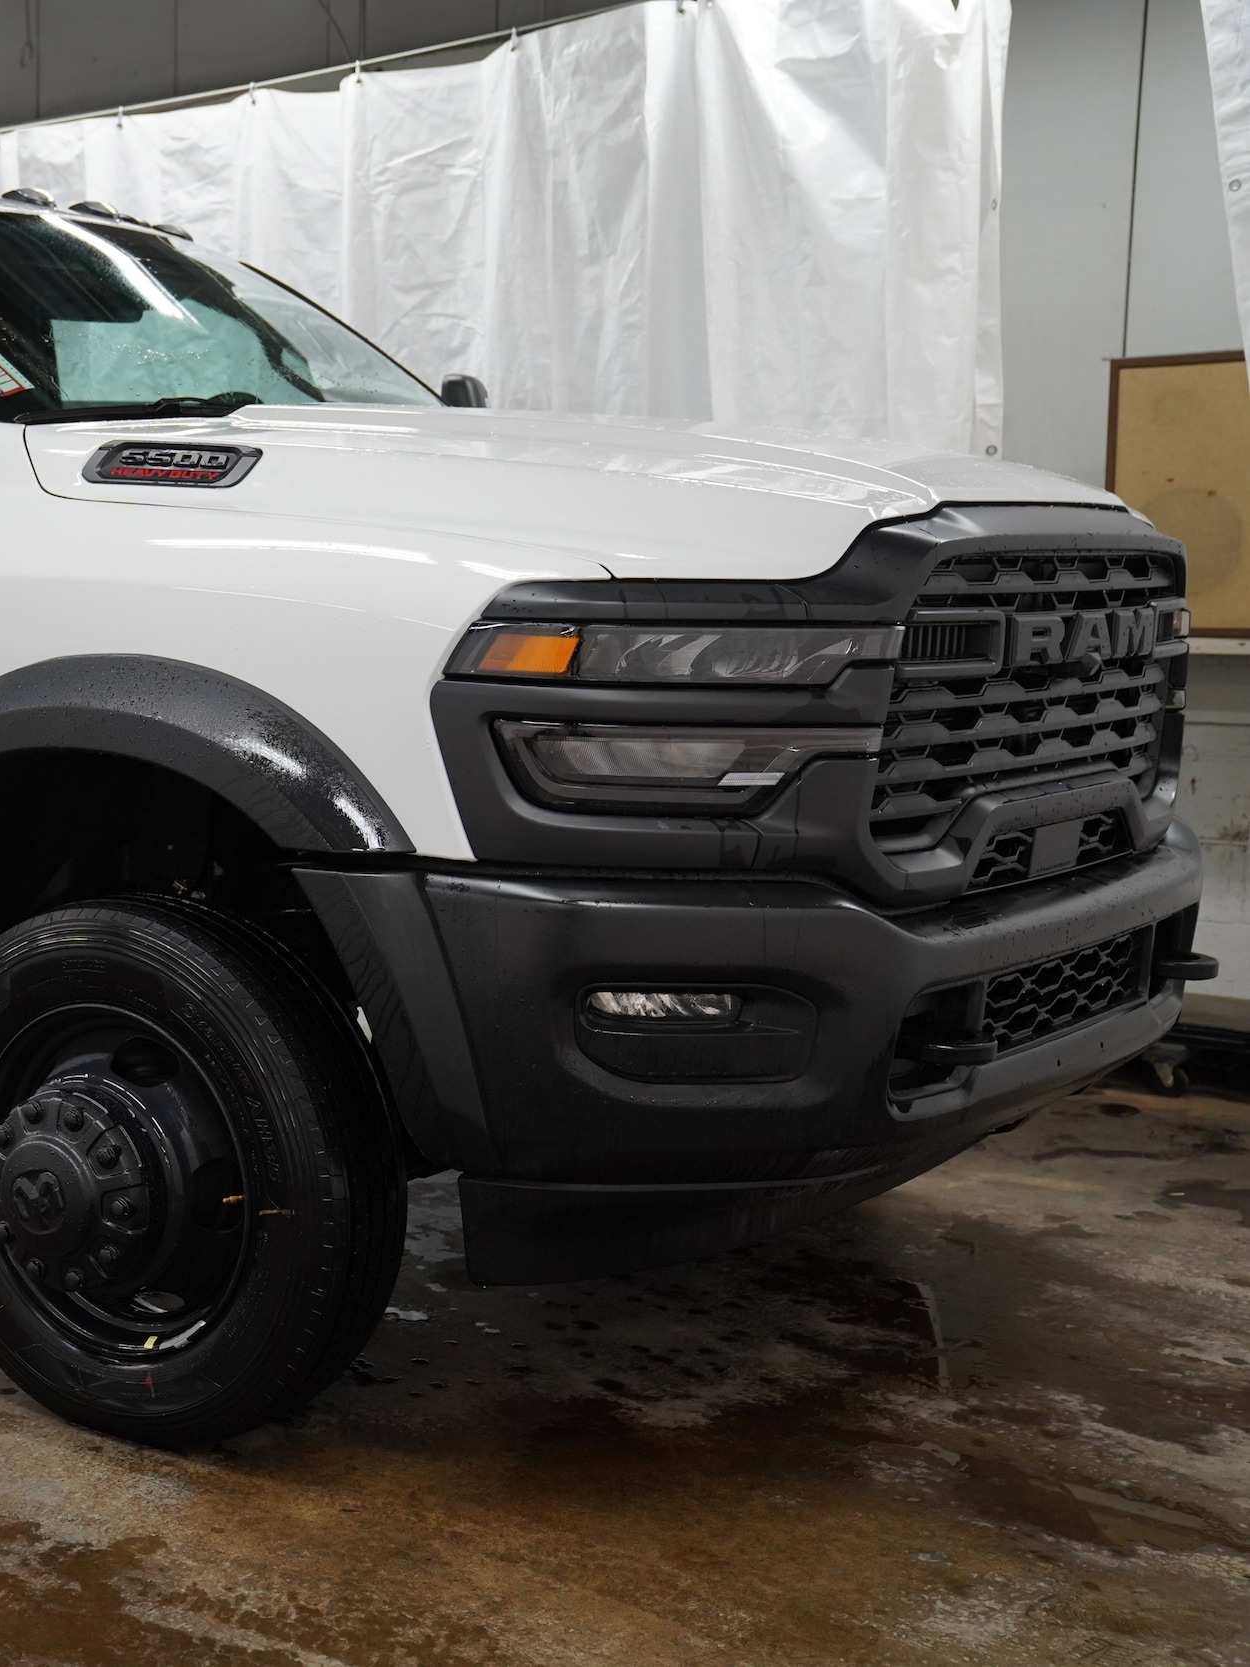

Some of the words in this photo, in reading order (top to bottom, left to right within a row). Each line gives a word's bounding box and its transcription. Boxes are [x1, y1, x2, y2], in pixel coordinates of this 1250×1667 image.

[111, 468, 168, 478] HEAVY
[170, 470, 220, 480] DUTY
[1012, 607, 1155, 666] RAM
